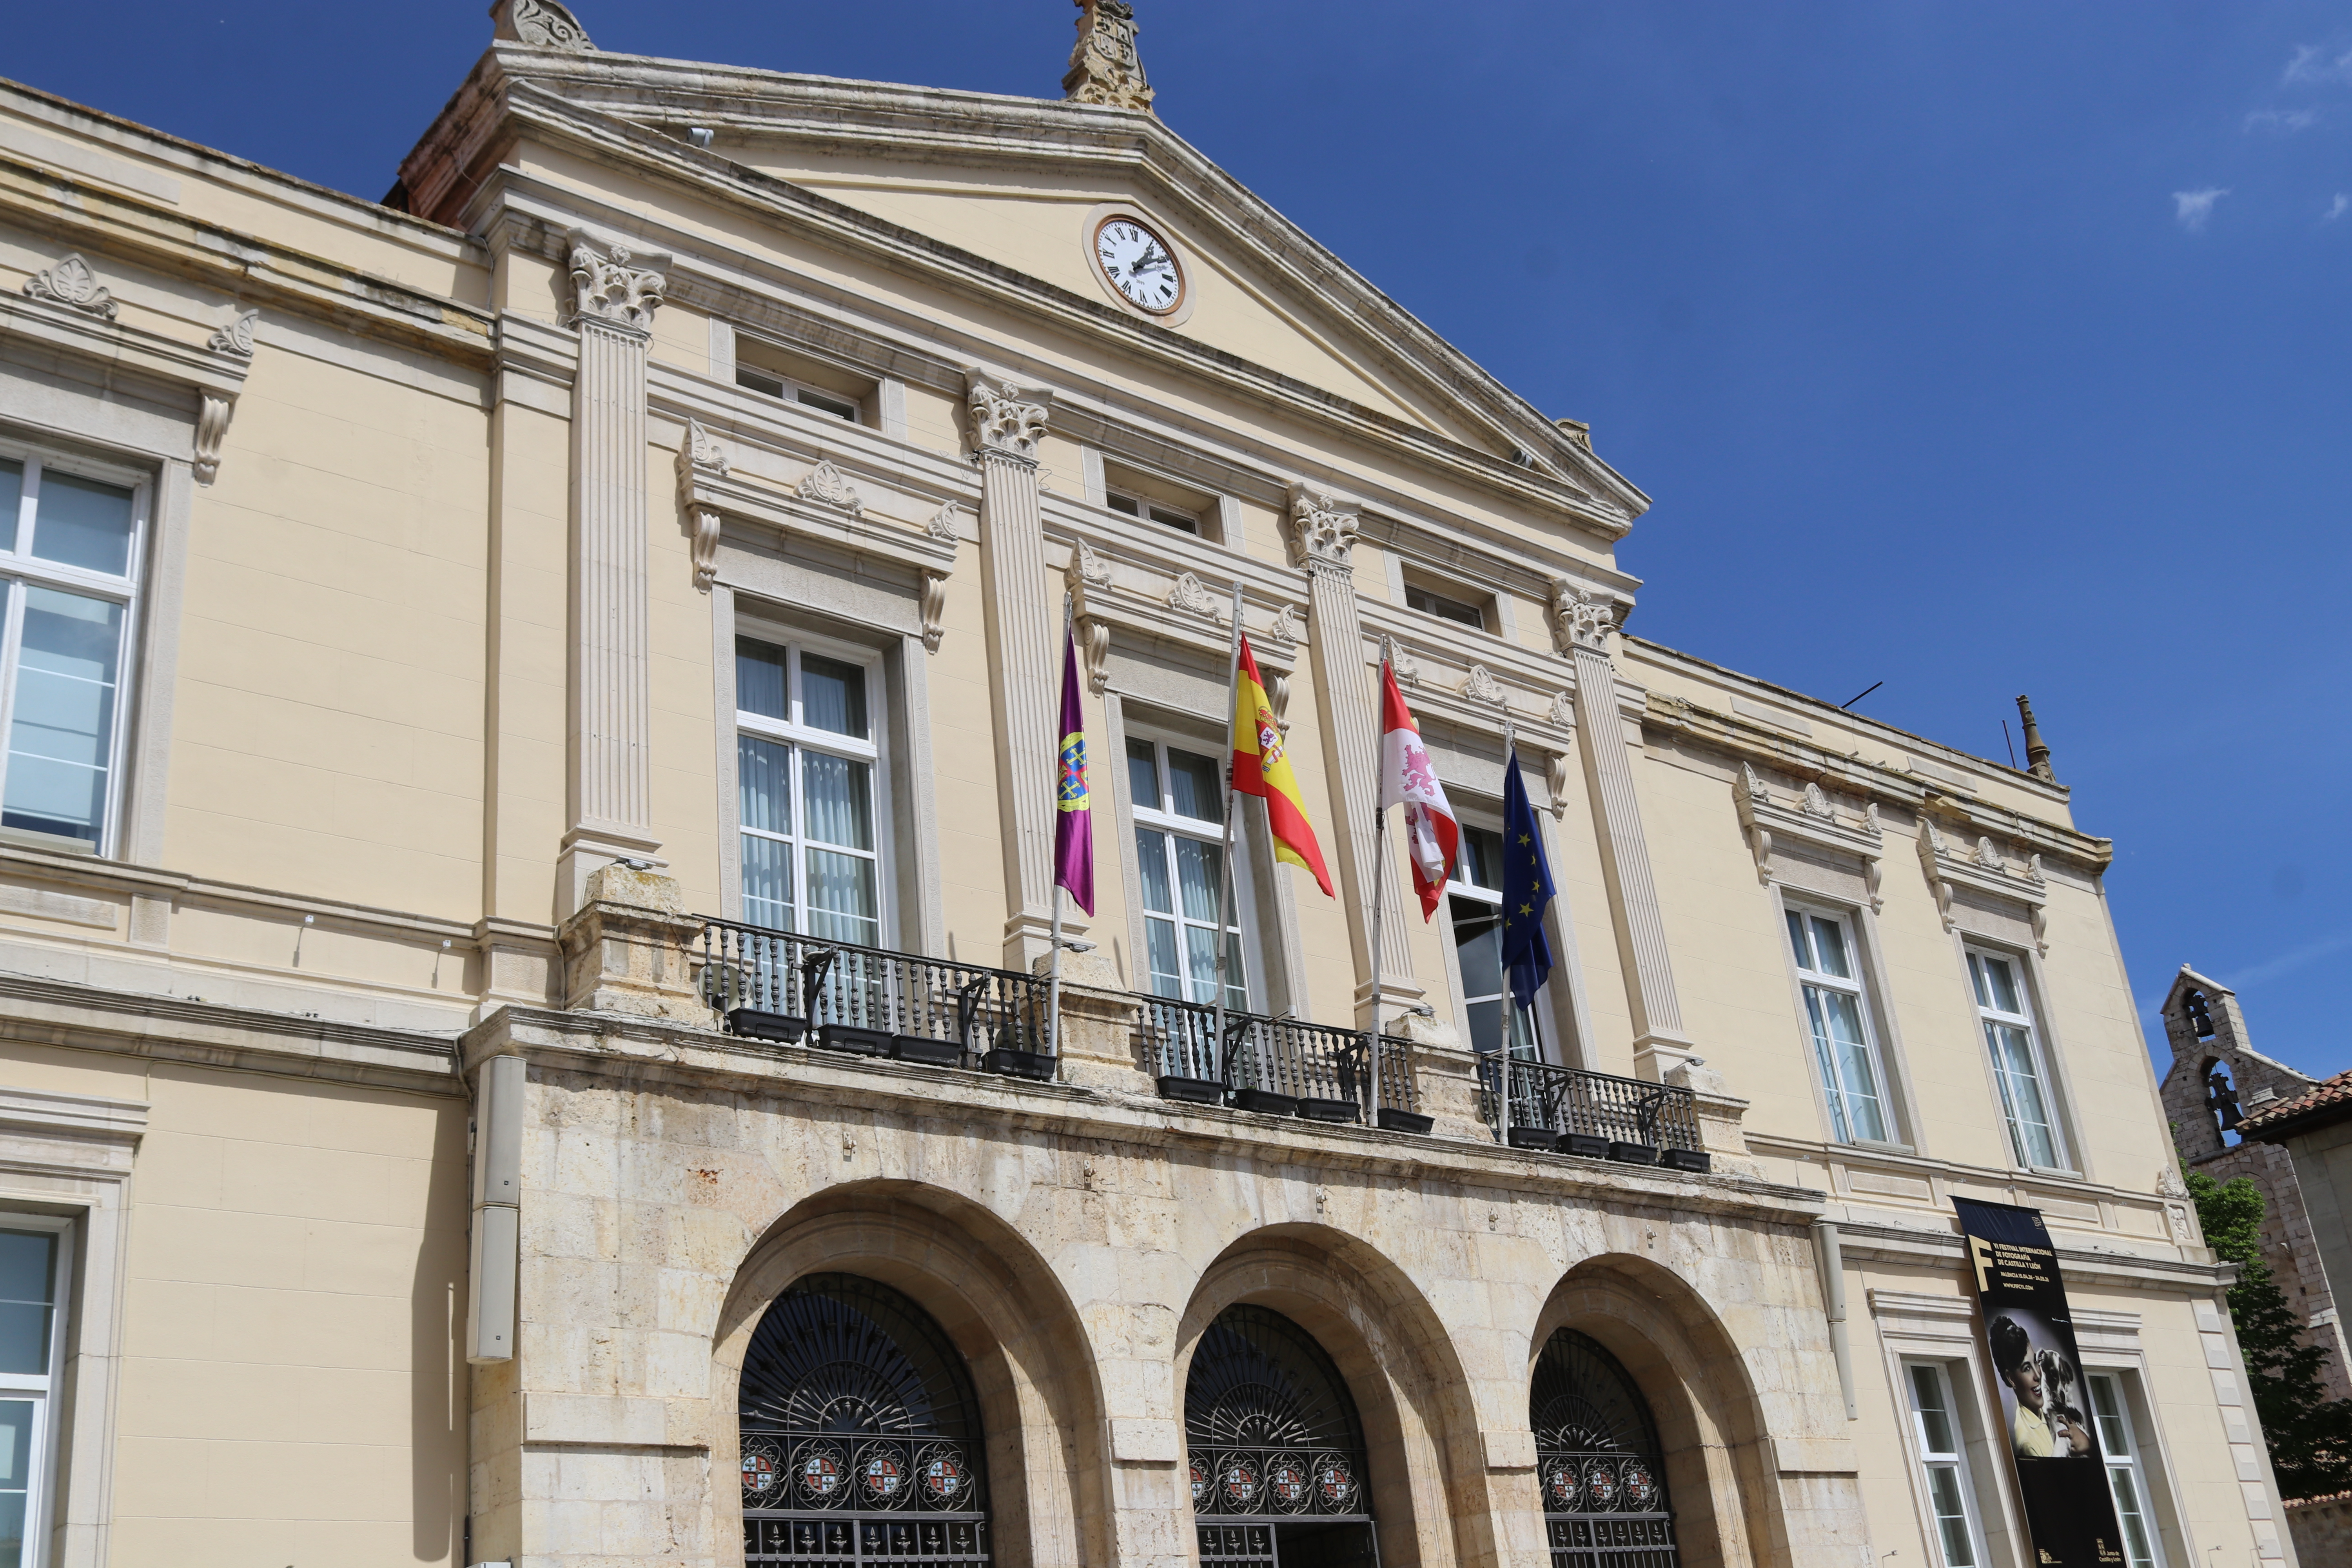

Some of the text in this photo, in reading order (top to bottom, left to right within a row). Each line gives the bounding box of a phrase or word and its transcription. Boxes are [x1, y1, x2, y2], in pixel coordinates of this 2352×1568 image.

[1105, 234, 1117, 247] X
[1129, 228, 1139, 243] XII
[1102, 247, 1115, 260] IX
[1107, 266, 1121, 279] VIII
[1121, 279, 1132, 295] VII
[1139, 289, 1148, 304] VI
[1999, 1243, 2019, 1252] FESTIVAL
[2018, 1246, 2053, 1256] INTERNACIONAL
[1968, 1234, 1994, 1292] F
[2002, 1252, 2032, 1261] FOTOGRAFÍA
[2004, 1259, 2027, 1268] CASTILLA
